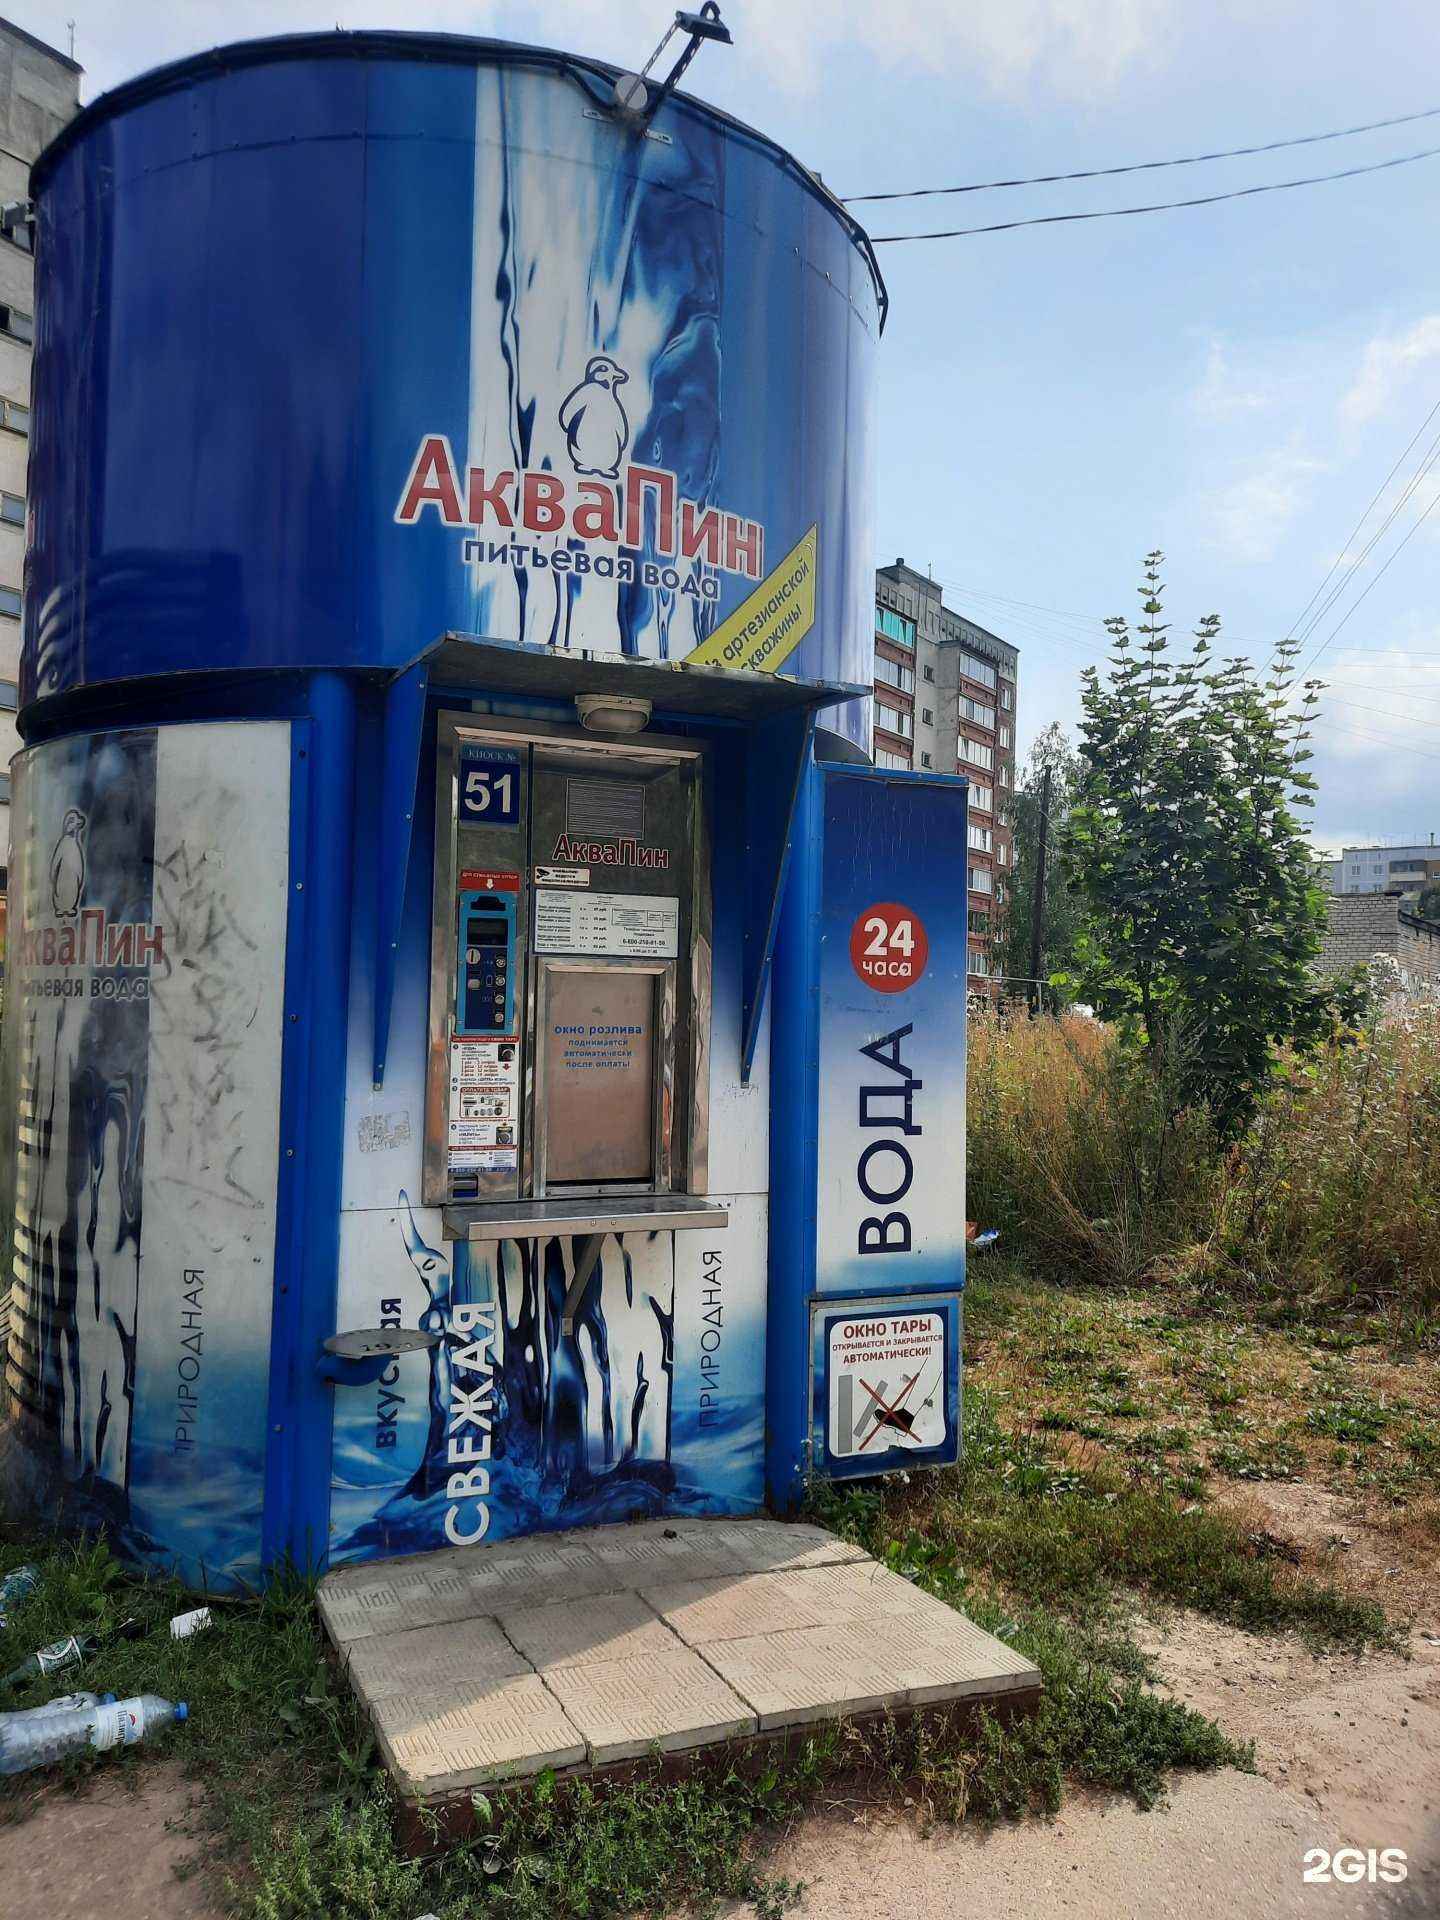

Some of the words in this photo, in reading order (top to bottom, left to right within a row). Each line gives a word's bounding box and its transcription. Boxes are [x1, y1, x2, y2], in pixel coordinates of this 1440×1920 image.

[398, 437, 763, 578] АкваПин
[464, 538, 633, 581] питьевая
[644, 561, 719, 600] вода
[722, 558, 809, 661] артезианской
[464, 771, 511, 813] 51
[552, 833, 669, 869] АкваПин
[863, 916, 915, 957] 24
[90, 977, 149, 1001] вода
[862, 960, 912, 977] часа
[554, 1026, 585, 1034] окно
[589, 1026, 642, 1036] розлива
[858, 1022, 923, 1255] ВОДА
[700, 1250, 723, 1428] ПРИРОДНАЯ
[832, 1339, 885, 1352] ОТКРЫВАЕТСЯ
[893, 1334, 943, 1346] ЗАКРЫВАЕТСЯ
[843, 1322, 887, 1339] ОКНО
[891, 1318, 932, 1335] ТАРЫ
[376, 1298, 405, 1449] ВКУСЯ
[843, 1346, 932, 1365] АВТОМАТИЧЕСКИ!
[445, 1303, 497, 1547] СВЕЖАЯ
